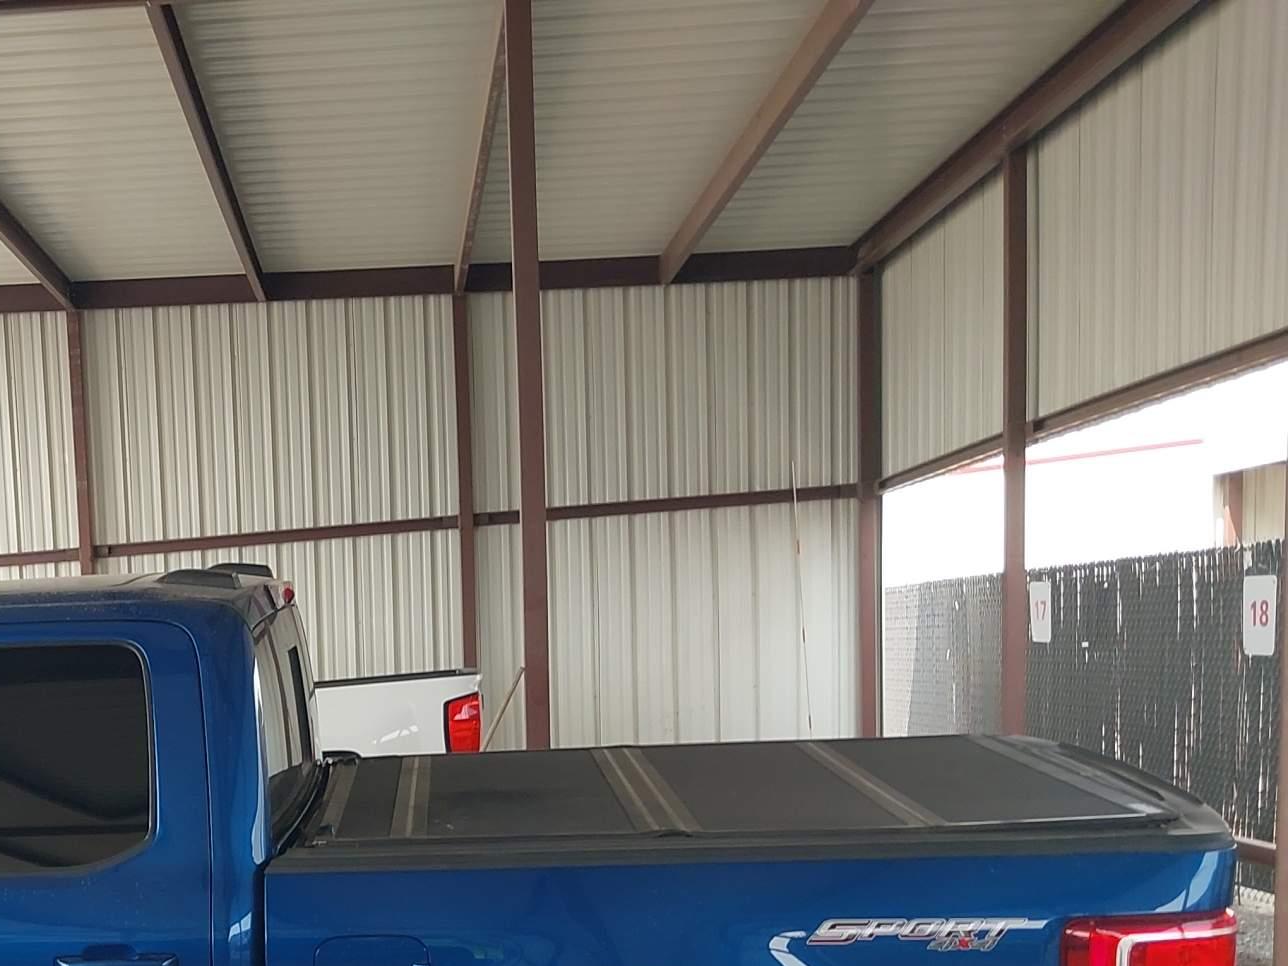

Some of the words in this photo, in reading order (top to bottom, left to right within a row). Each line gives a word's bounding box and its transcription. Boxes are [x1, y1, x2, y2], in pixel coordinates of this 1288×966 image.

[1035, 600, 1047, 621] 17
[1250, 599, 1269, 627] 18
[806, 917, 1029, 947] SPORT
